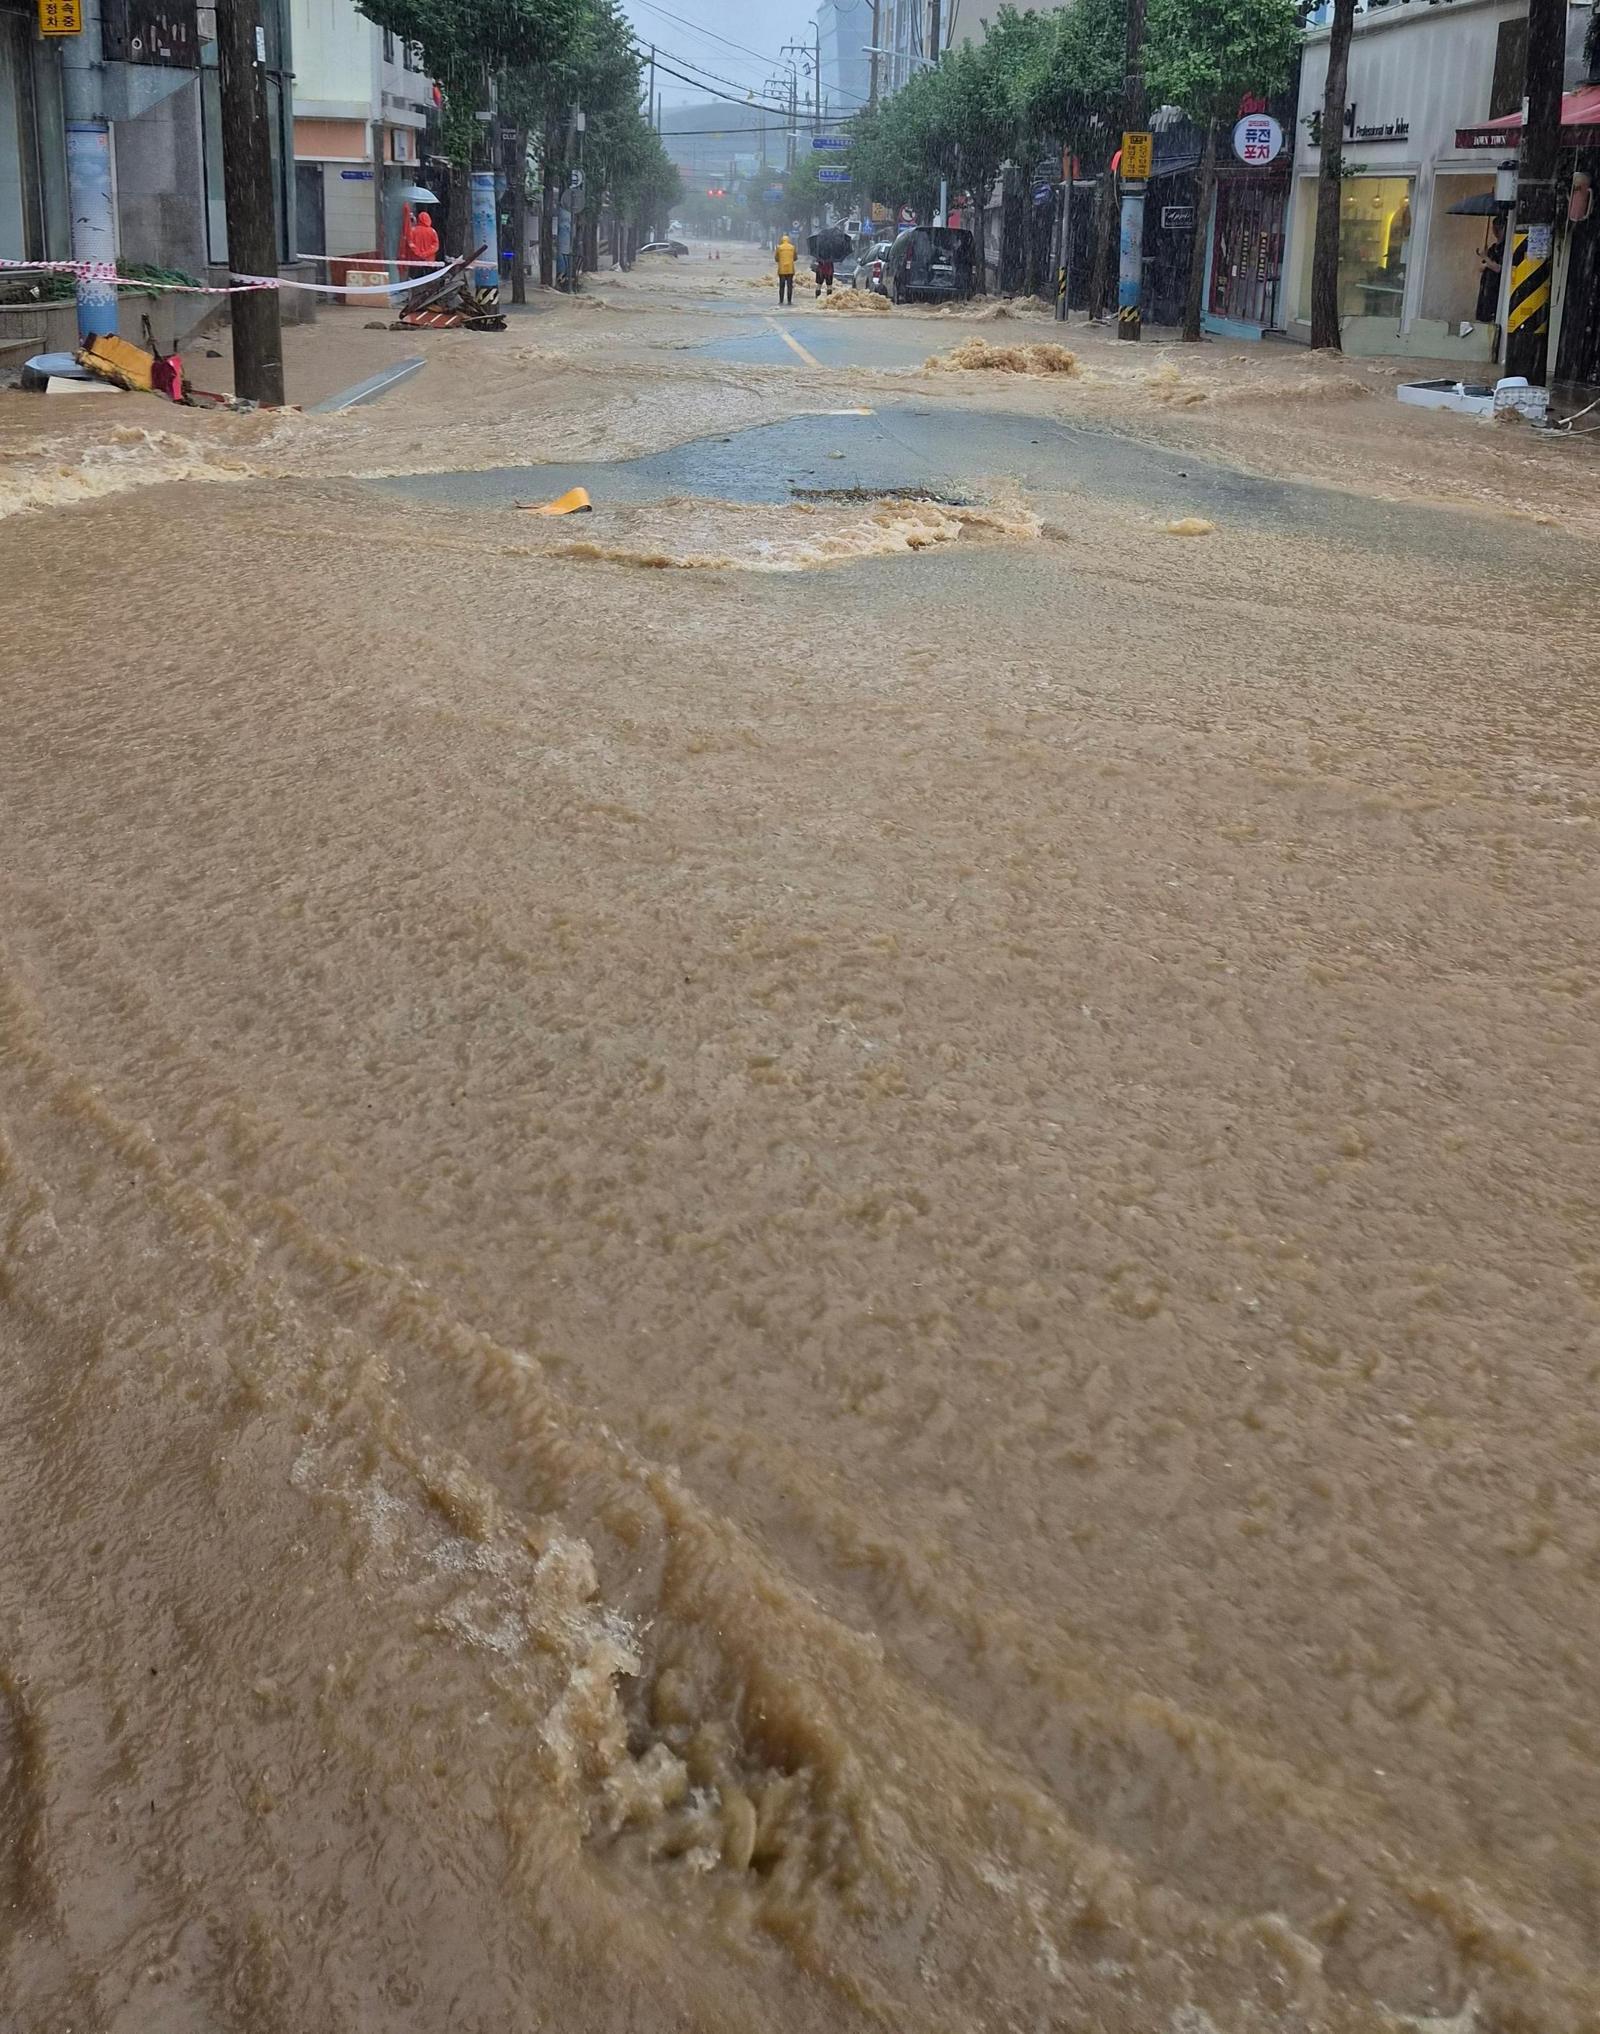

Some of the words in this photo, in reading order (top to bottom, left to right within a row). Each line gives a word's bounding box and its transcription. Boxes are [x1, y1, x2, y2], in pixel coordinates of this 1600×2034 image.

[46, 0, 58, 27] 정차
[61, 0, 76, 27] 속중
[1245, 128, 1271, 143] 퓨전
